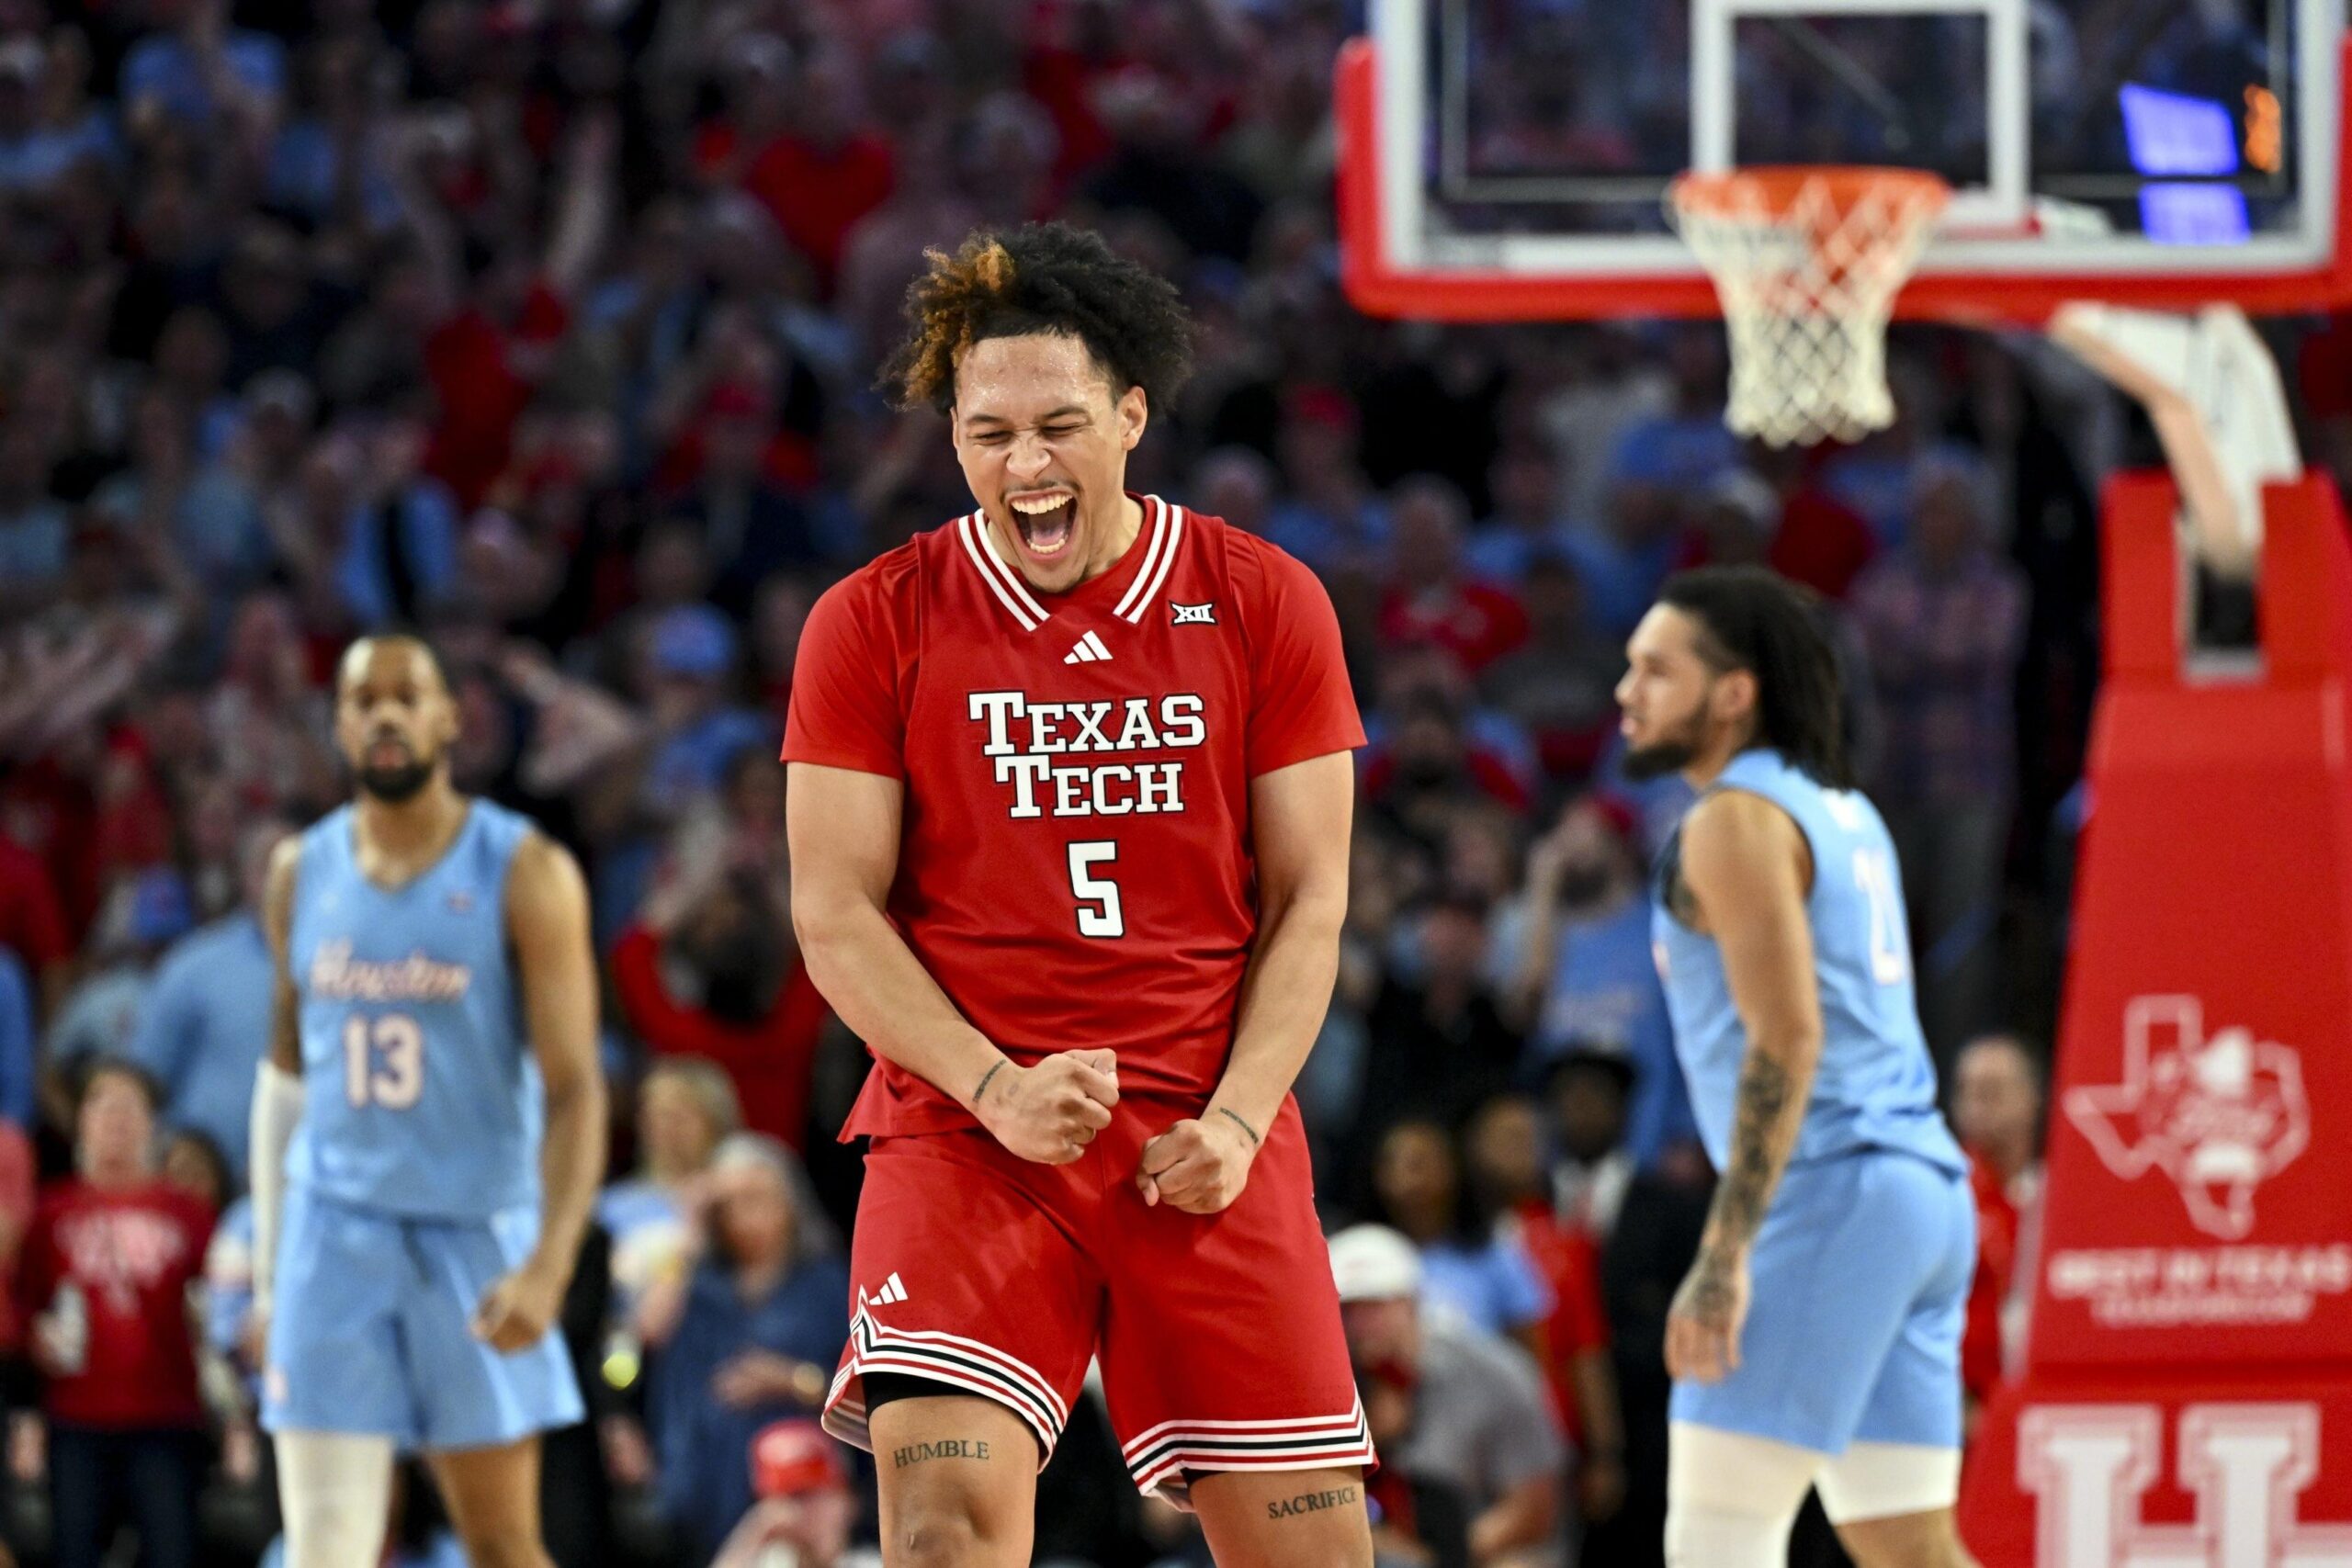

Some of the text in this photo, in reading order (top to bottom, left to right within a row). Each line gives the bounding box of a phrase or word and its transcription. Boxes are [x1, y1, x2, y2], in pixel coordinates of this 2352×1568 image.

[1066, 840, 1125, 939] 5
[344, 1013, 424, 1111] 13
[893, 1439, 989, 1469] HUMBLE
